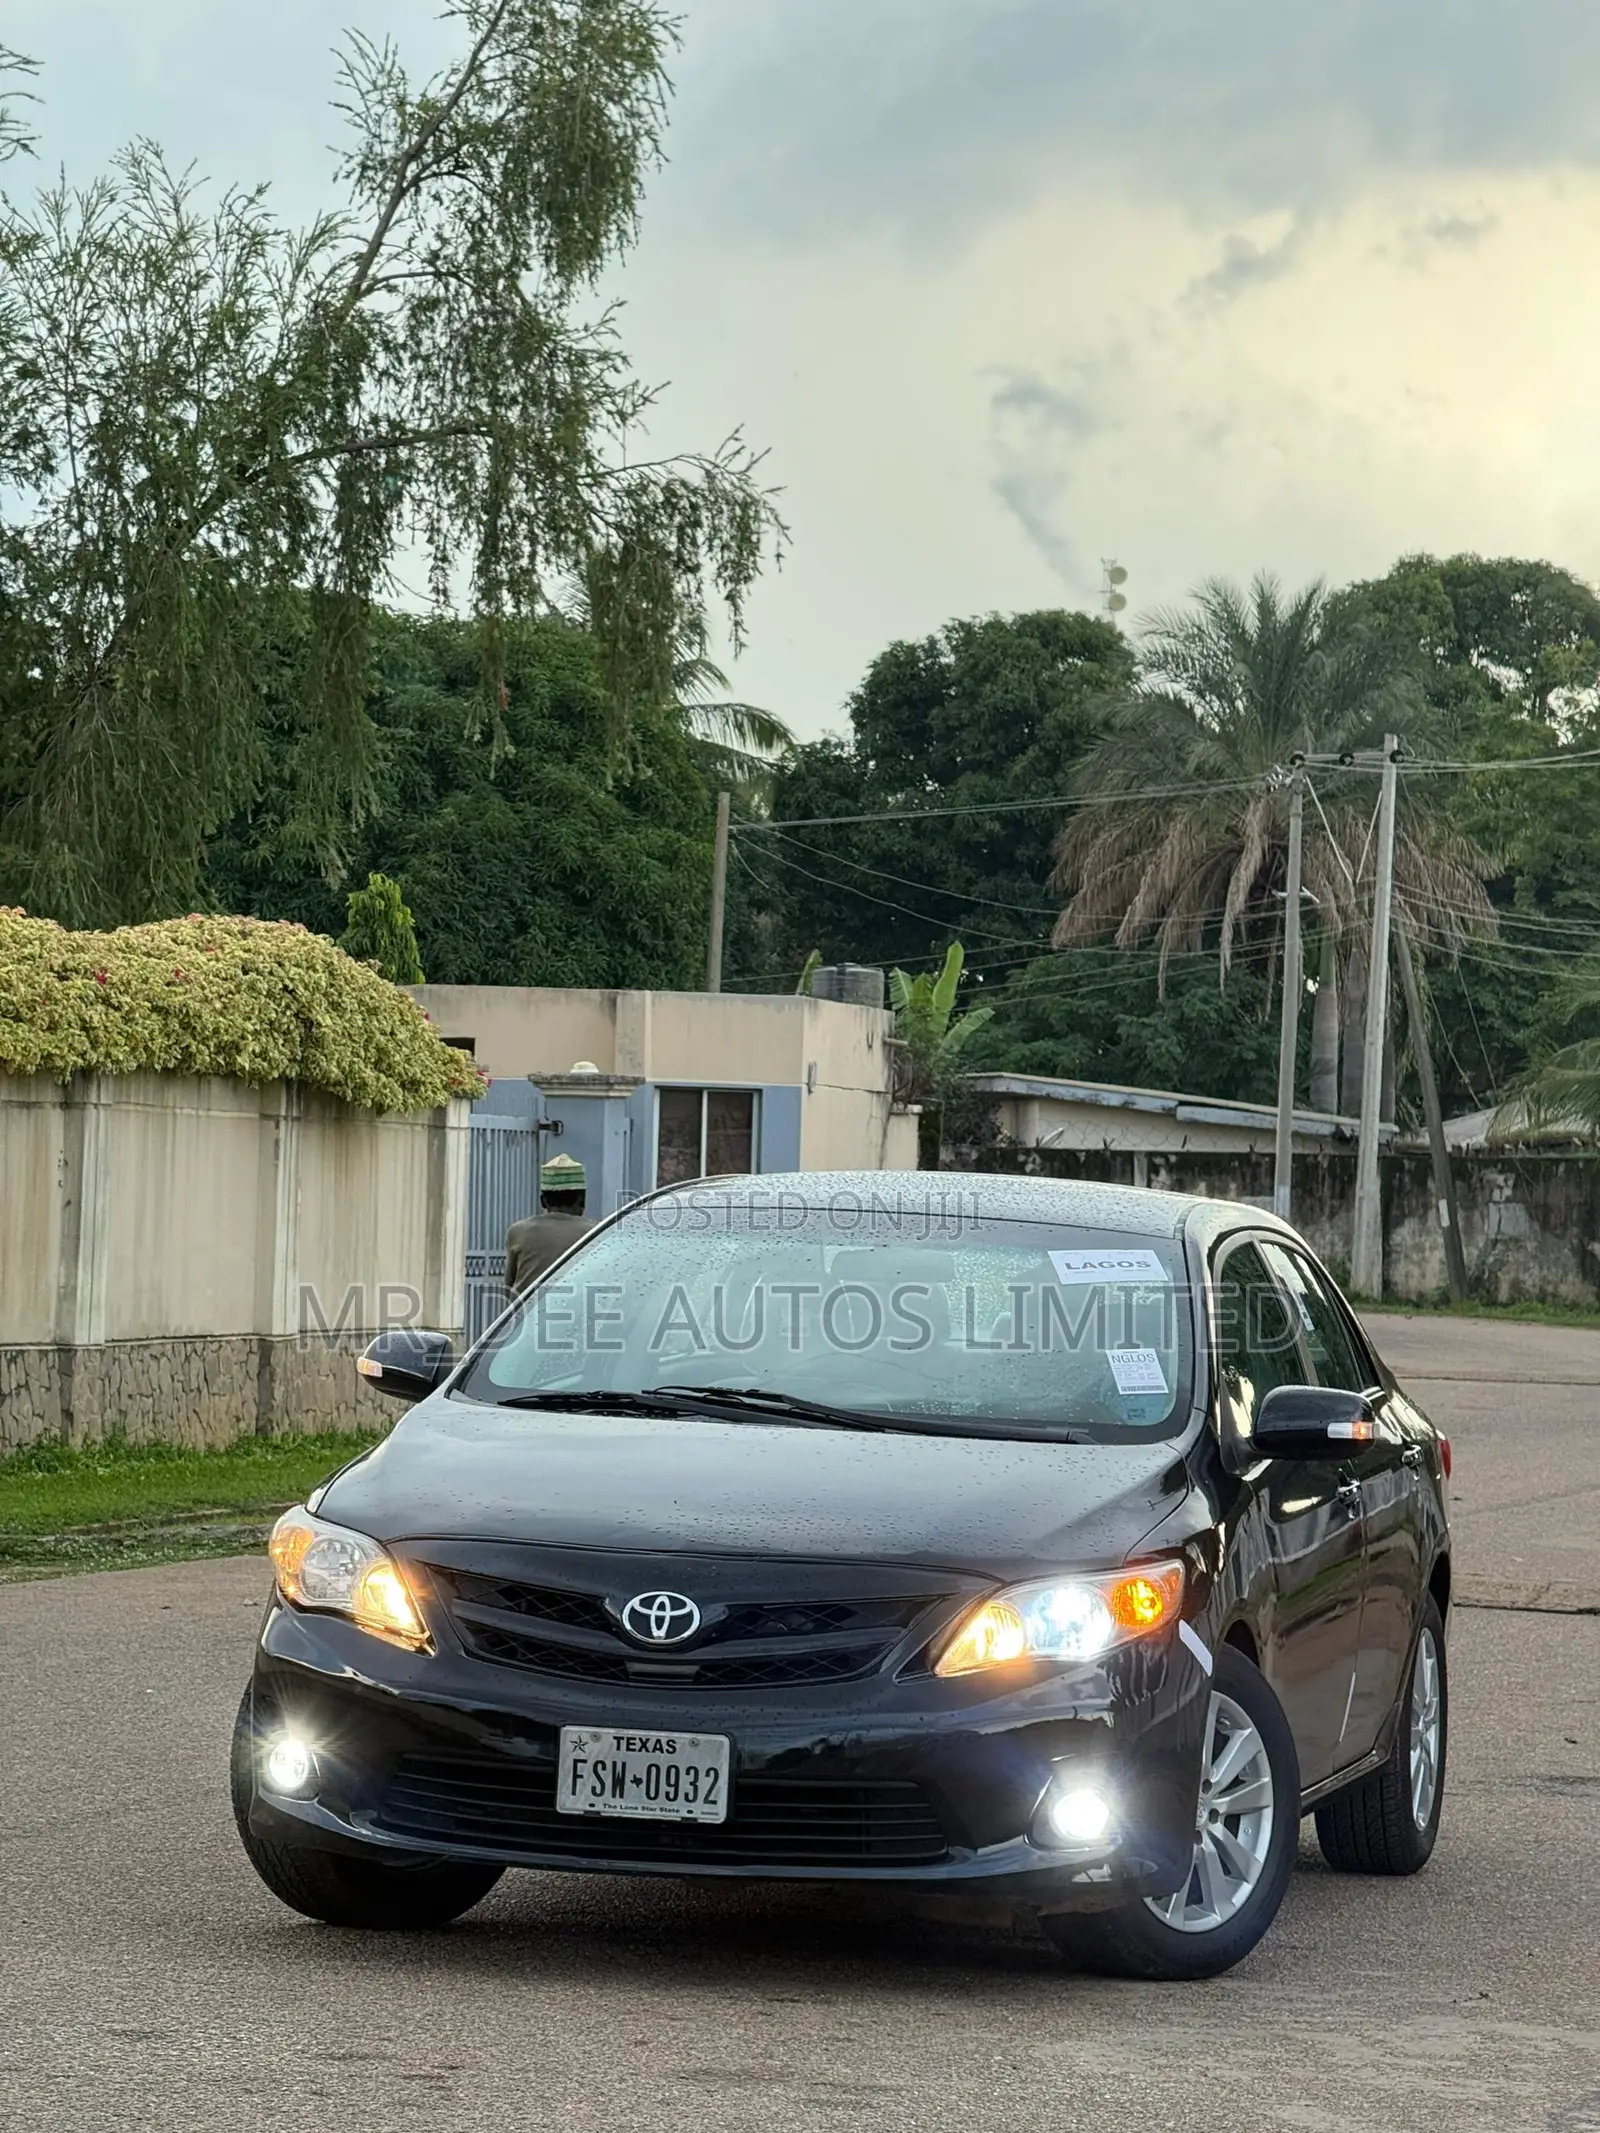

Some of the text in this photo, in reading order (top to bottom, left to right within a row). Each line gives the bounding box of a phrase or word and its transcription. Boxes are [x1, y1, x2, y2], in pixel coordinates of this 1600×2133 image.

[1064, 1260, 1152, 1270] LAGOS
[1111, 1353, 1156, 1364] NGLOS
[613, 1735, 677, 1755] TEXAS
[659, 1806, 680, 1814] State
